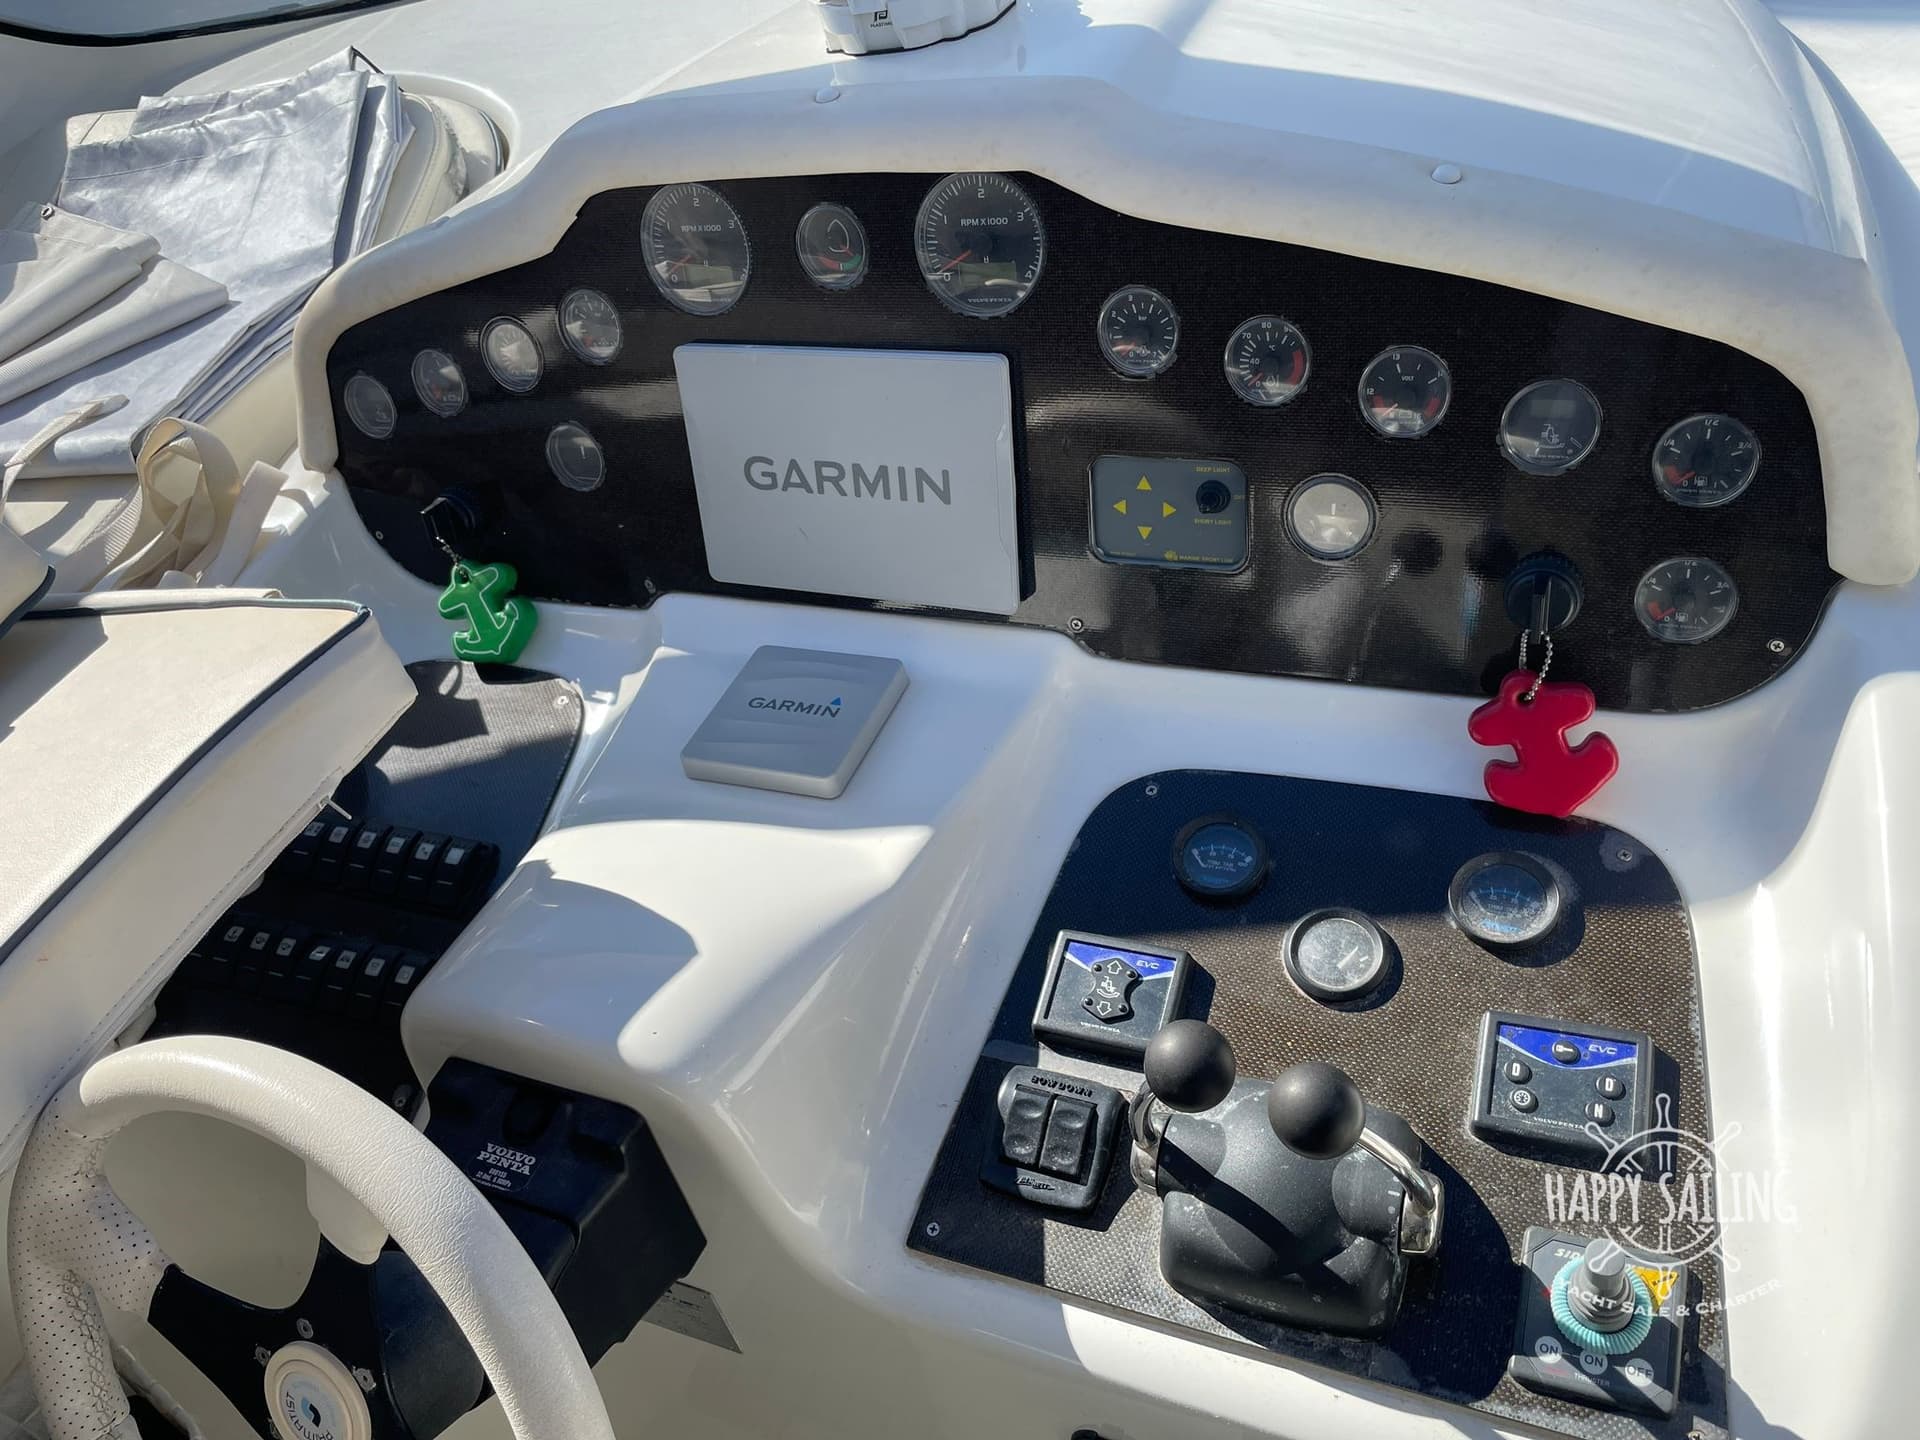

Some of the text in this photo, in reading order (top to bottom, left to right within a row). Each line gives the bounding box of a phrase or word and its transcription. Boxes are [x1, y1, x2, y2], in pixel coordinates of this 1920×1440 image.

[977, 188, 985, 199] 2
[1017, 211, 1025, 222] 3
[727, 219, 735, 229] 3
[960, 218, 979, 227] RPM
[943, 272, 952, 282] 0
[1024, 270, 1033, 280] 4
[1366, 387, 1376, 396] 12
[743, 455, 952, 505] GARMIN
[747, 696, 842, 718] GARMIN
[1136, 960, 1160, 970] EVC
[1588, 1044, 1618, 1055] EVC
[1533, 1116, 1585, 1130] VOLVO PENTA
[486, 1142, 537, 1166] VOLVO
[476, 1150, 531, 1176] PENTA
[1539, 1342, 1560, 1356] ON
[1584, 1353, 1605, 1368] ON
[1626, 1363, 1655, 1379] OFF
